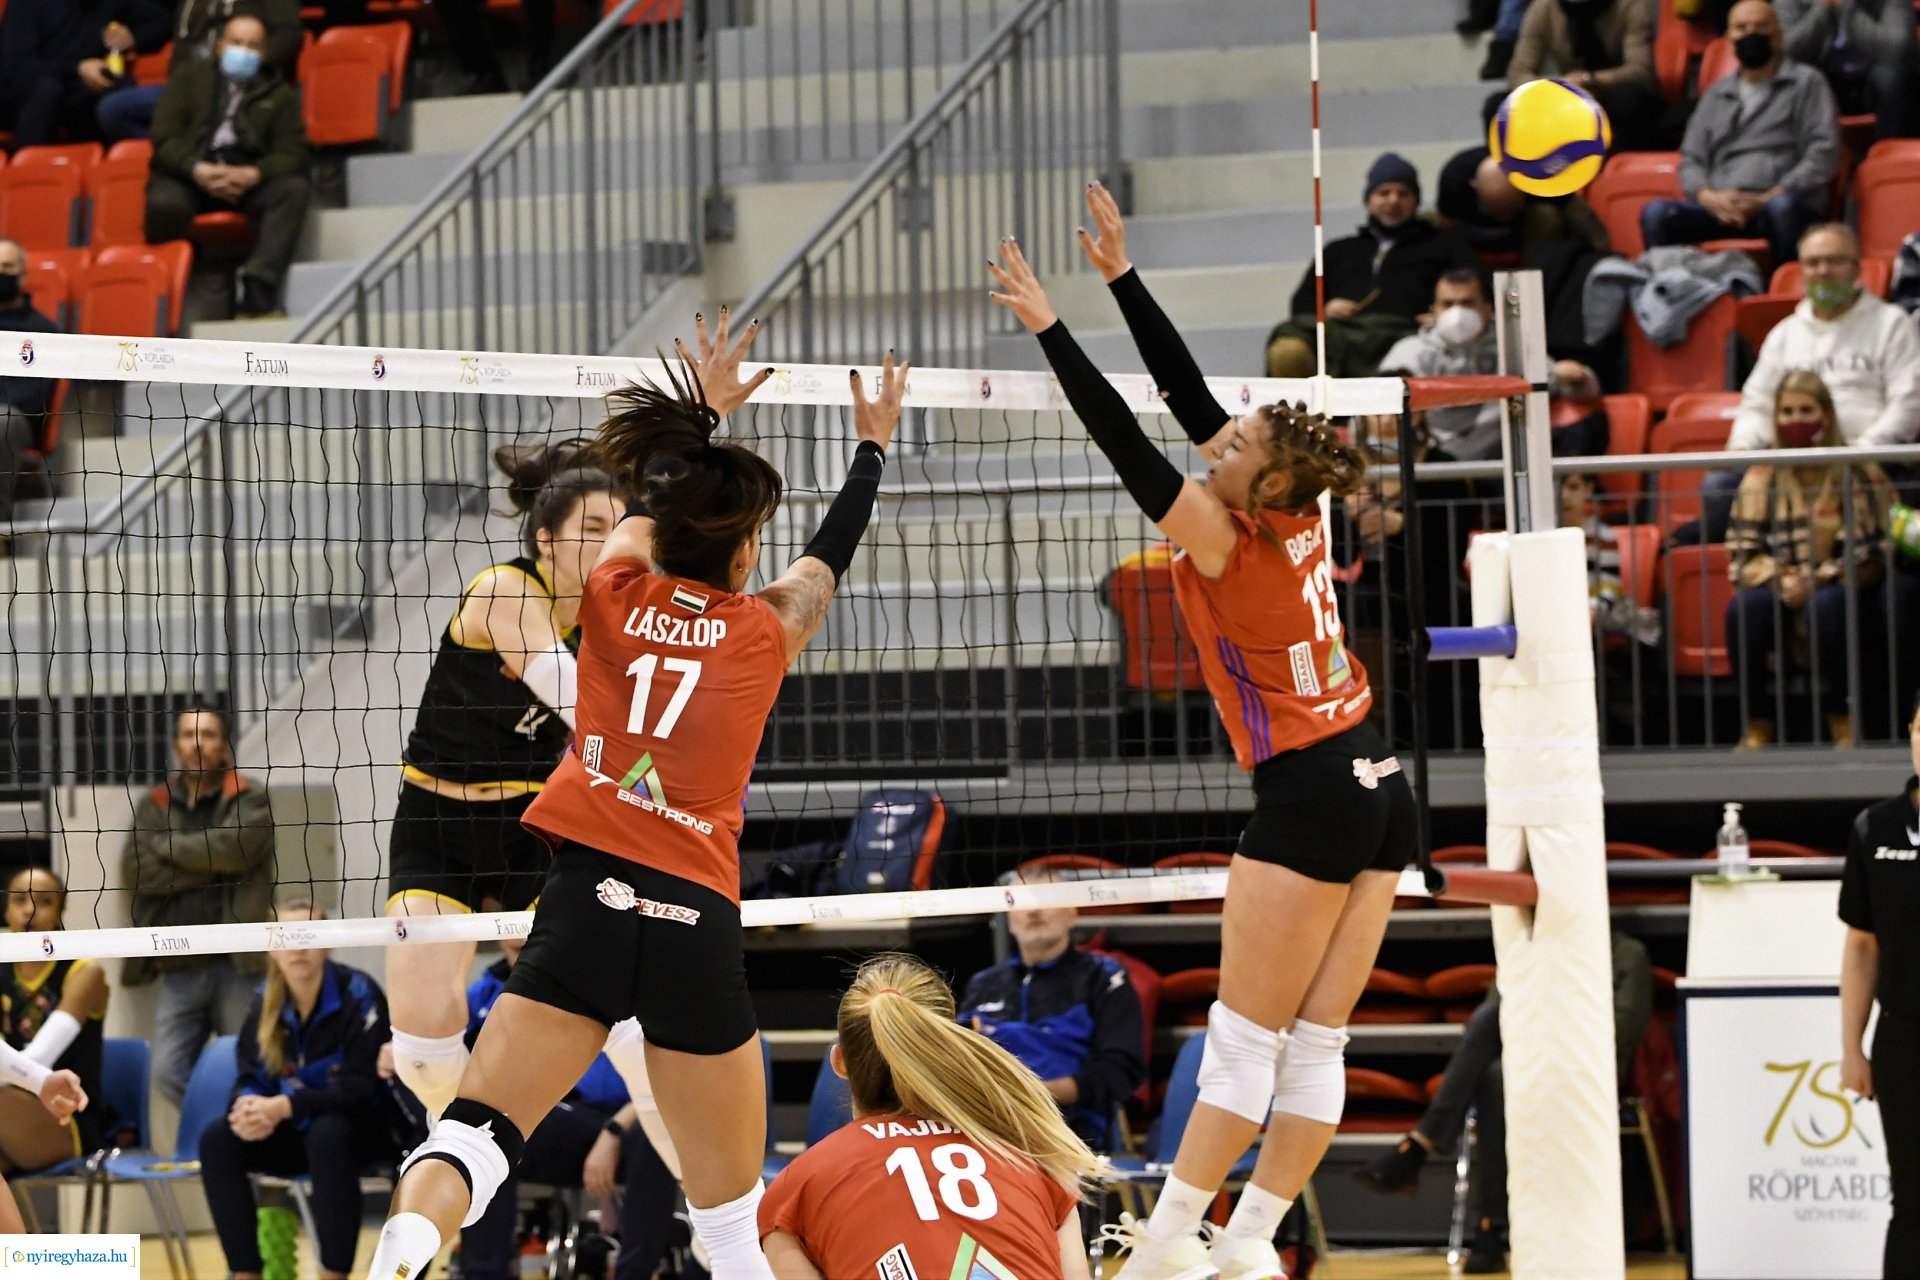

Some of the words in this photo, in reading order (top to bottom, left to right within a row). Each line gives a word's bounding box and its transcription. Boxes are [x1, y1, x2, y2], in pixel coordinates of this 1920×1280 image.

[1301, 560, 1341, 641] 13
[623, 606, 727, 648] LÁSZLOP
[625, 653, 703, 740] 17
[616, 788, 714, 836] BESTRONG
[861, 1119, 961, 1139] VAJD
[885, 1143, 998, 1221] 18
[1749, 1167, 1892, 1201] RÖPLABD
